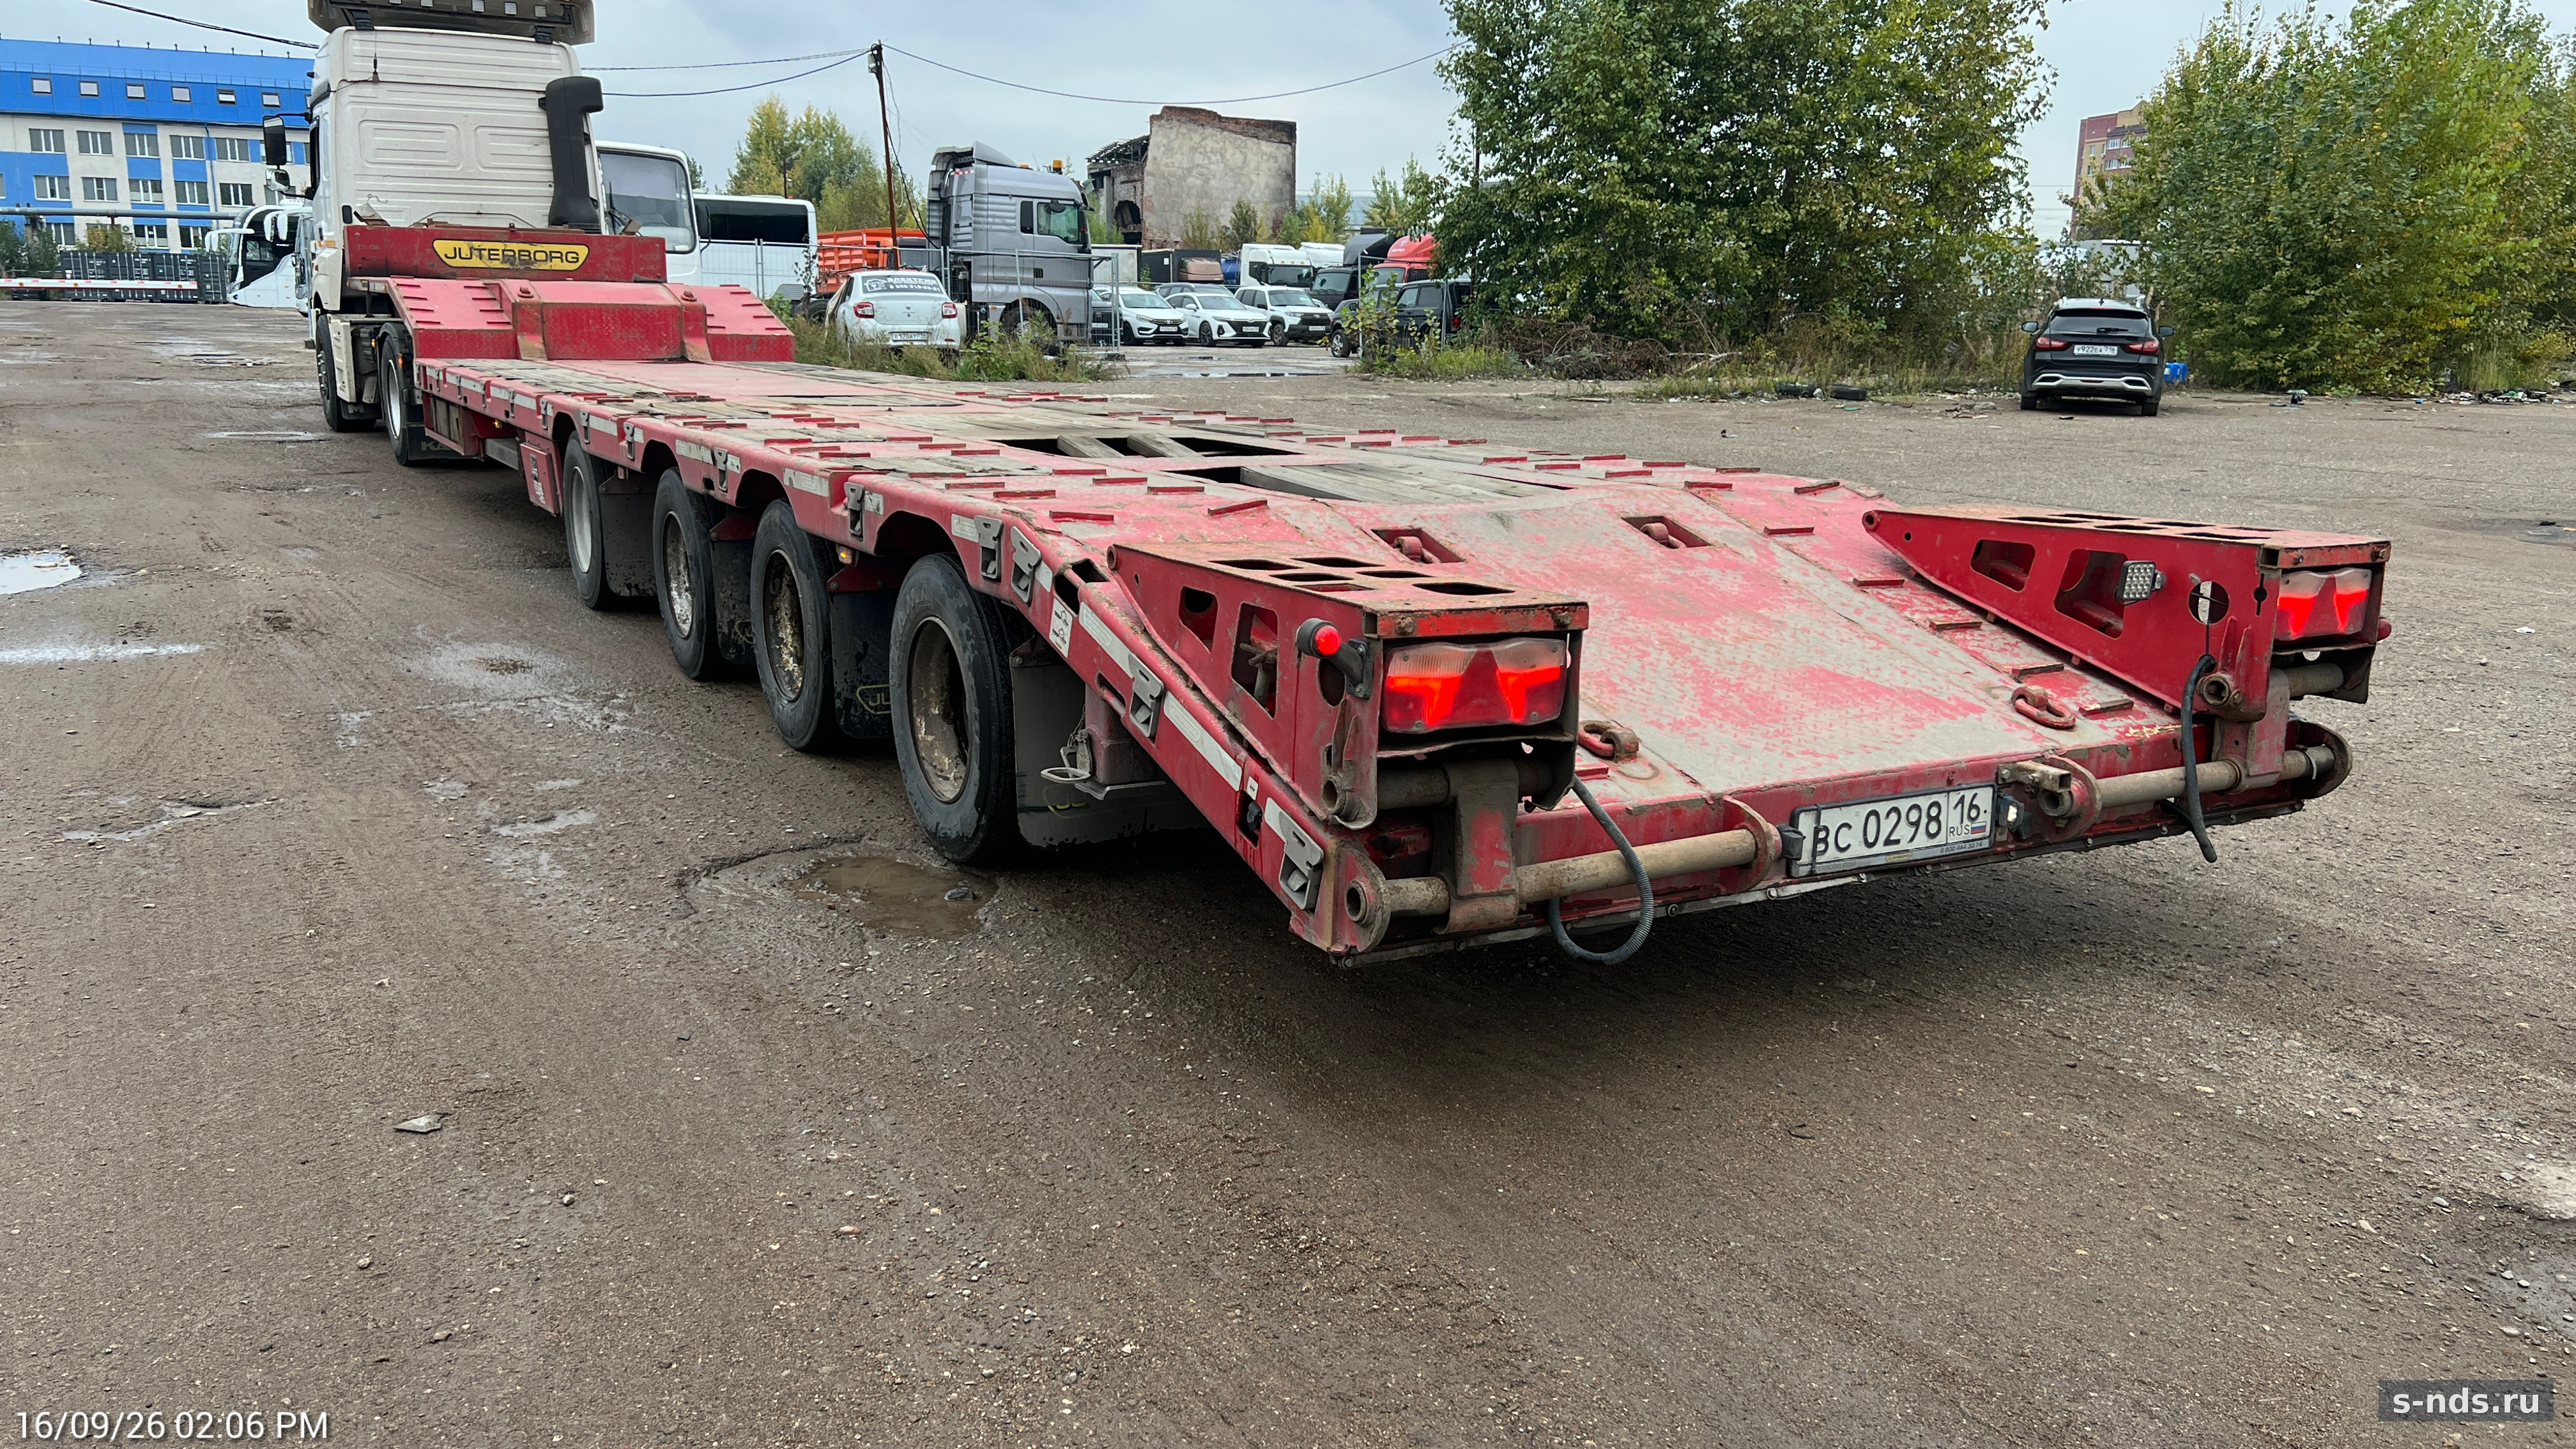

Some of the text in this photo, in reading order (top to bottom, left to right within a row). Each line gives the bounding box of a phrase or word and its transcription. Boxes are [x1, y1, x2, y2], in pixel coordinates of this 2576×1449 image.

[1864, 801, 1941, 848] 0298
[1952, 792, 1981, 824] 16
[1949, 823, 1970, 837] RUS
